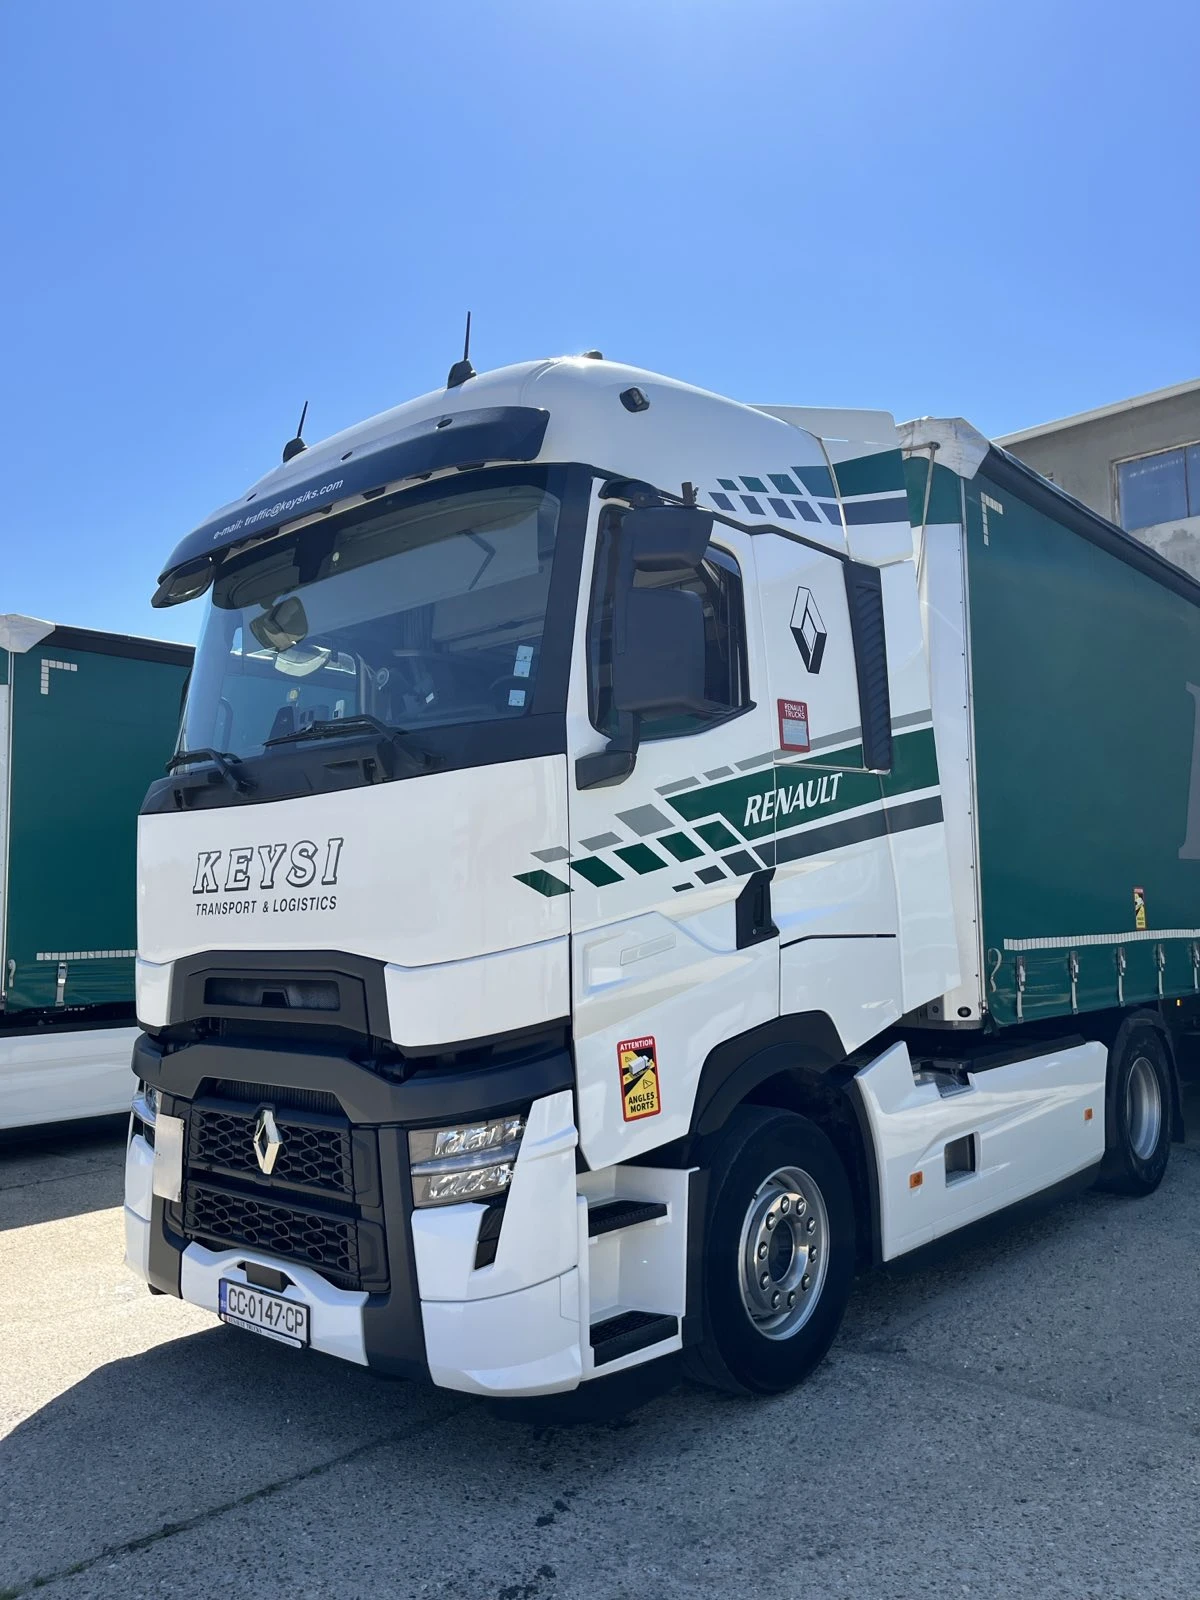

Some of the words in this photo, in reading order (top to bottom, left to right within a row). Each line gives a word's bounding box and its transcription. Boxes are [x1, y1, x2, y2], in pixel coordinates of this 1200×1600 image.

[244, 479, 344, 527] traffic@keysiks.com
[784, 702, 804, 712] RENAULT
[785, 709, 806, 719] TRUCKS
[743, 772, 843, 827] RENAULT
[192, 837, 344, 894] KEYSI
[195, 900, 257, 916] TRANSPORT
[262, 900, 269, 913] &
[272, 895, 337, 913] LOGISTICS
[620, 1038, 653, 1051] ATTENTION
[628, 1092, 654, 1104] ANGLES
[630, 1101, 654, 1113] MORTS
